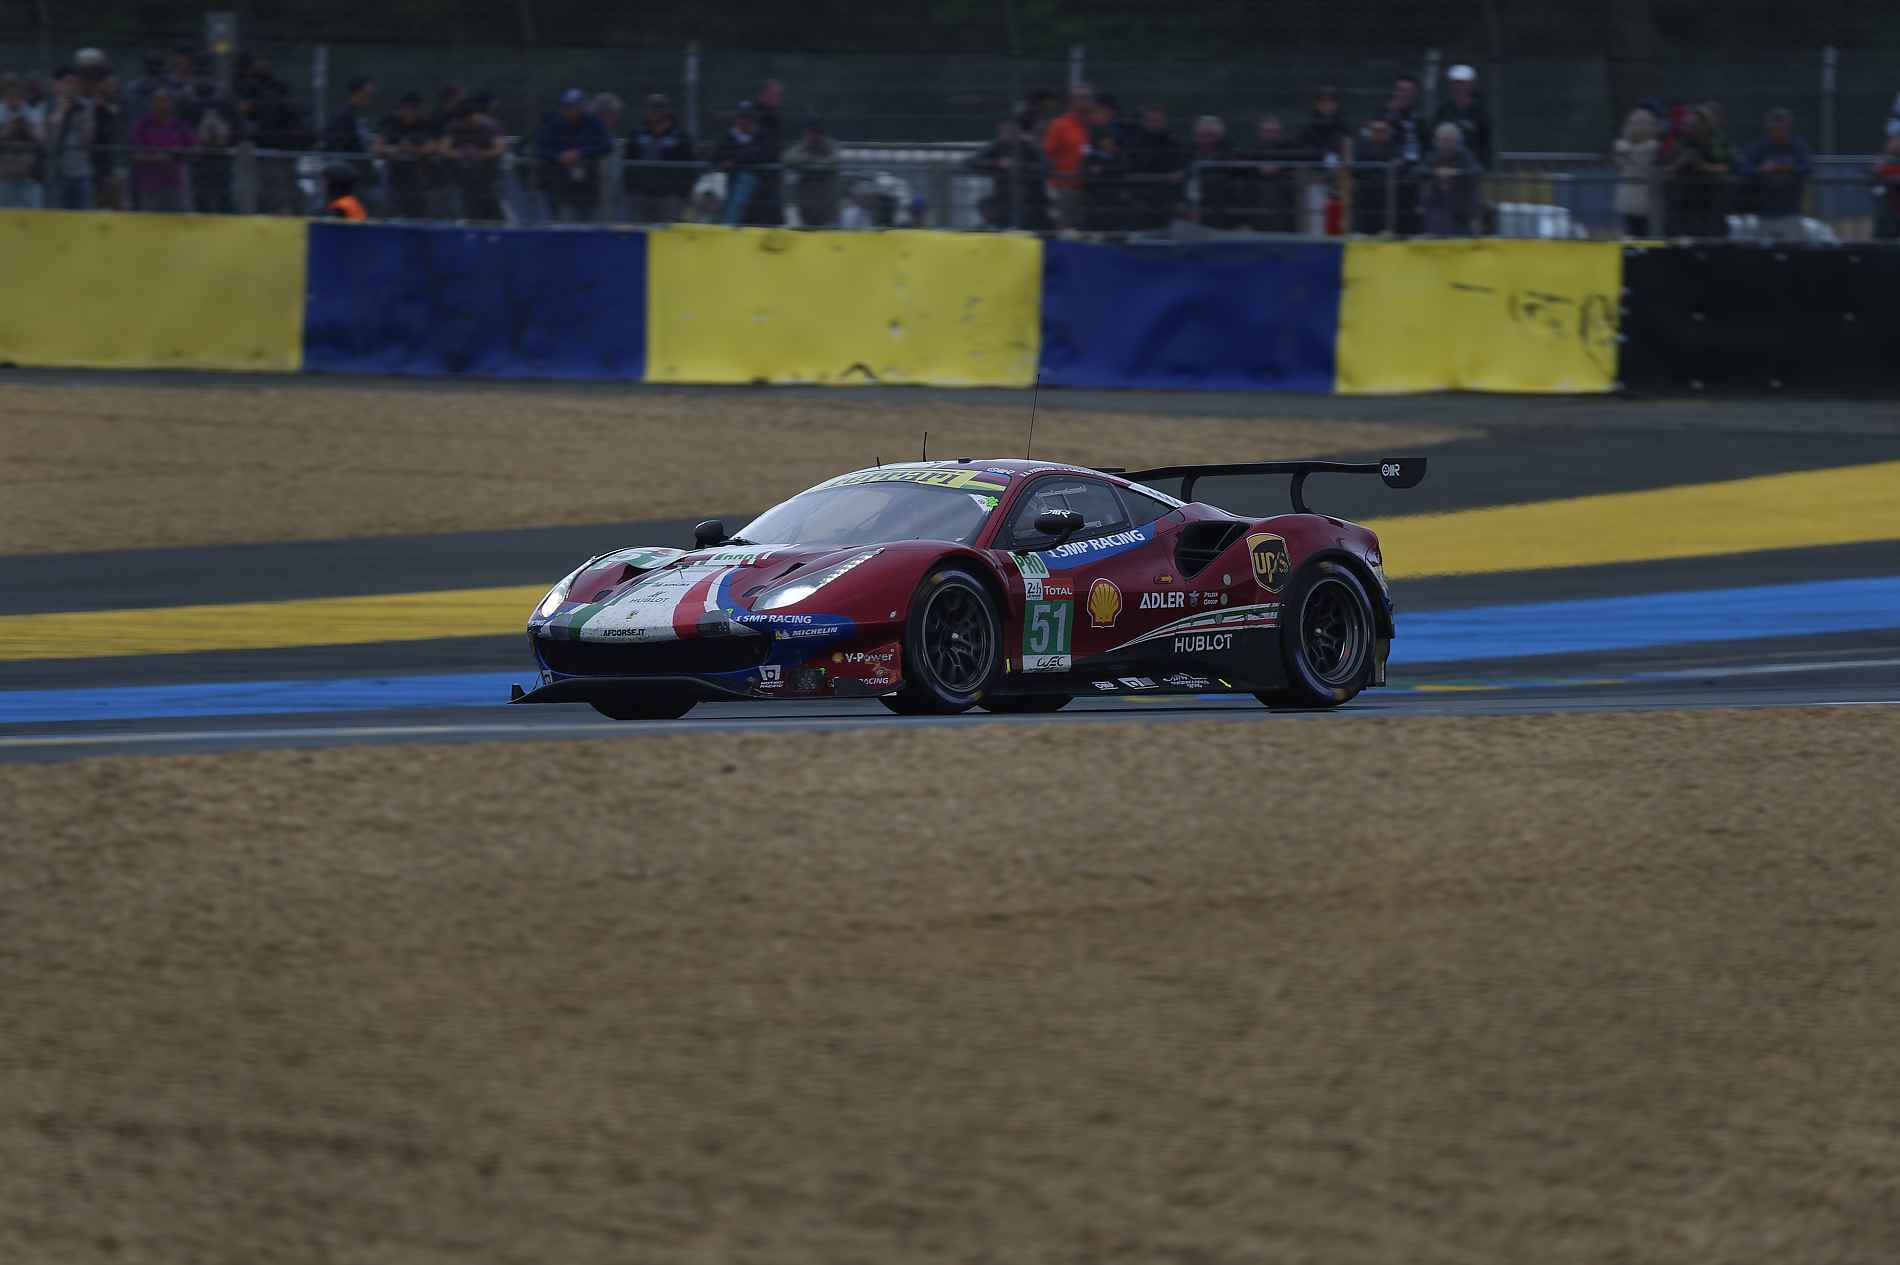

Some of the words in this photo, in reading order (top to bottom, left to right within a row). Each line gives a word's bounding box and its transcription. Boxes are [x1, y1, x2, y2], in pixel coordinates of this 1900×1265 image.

[1058, 541, 1089, 558] SMP
[1088, 529, 1146, 551] RACING
[1012, 552, 1047, 574] PRO
[1044, 586, 1073, 595] TOTAL
[1139, 591, 1185, 608] ADLER
[743, 615, 767, 623] SMP
[768, 615, 812, 624] RACING
[1030, 603, 1068, 653] 51
[792, 627, 838, 637] MICHELIN
[1174, 634, 1232, 653] HUBLOT
[845, 652, 893, 662] V-Power
